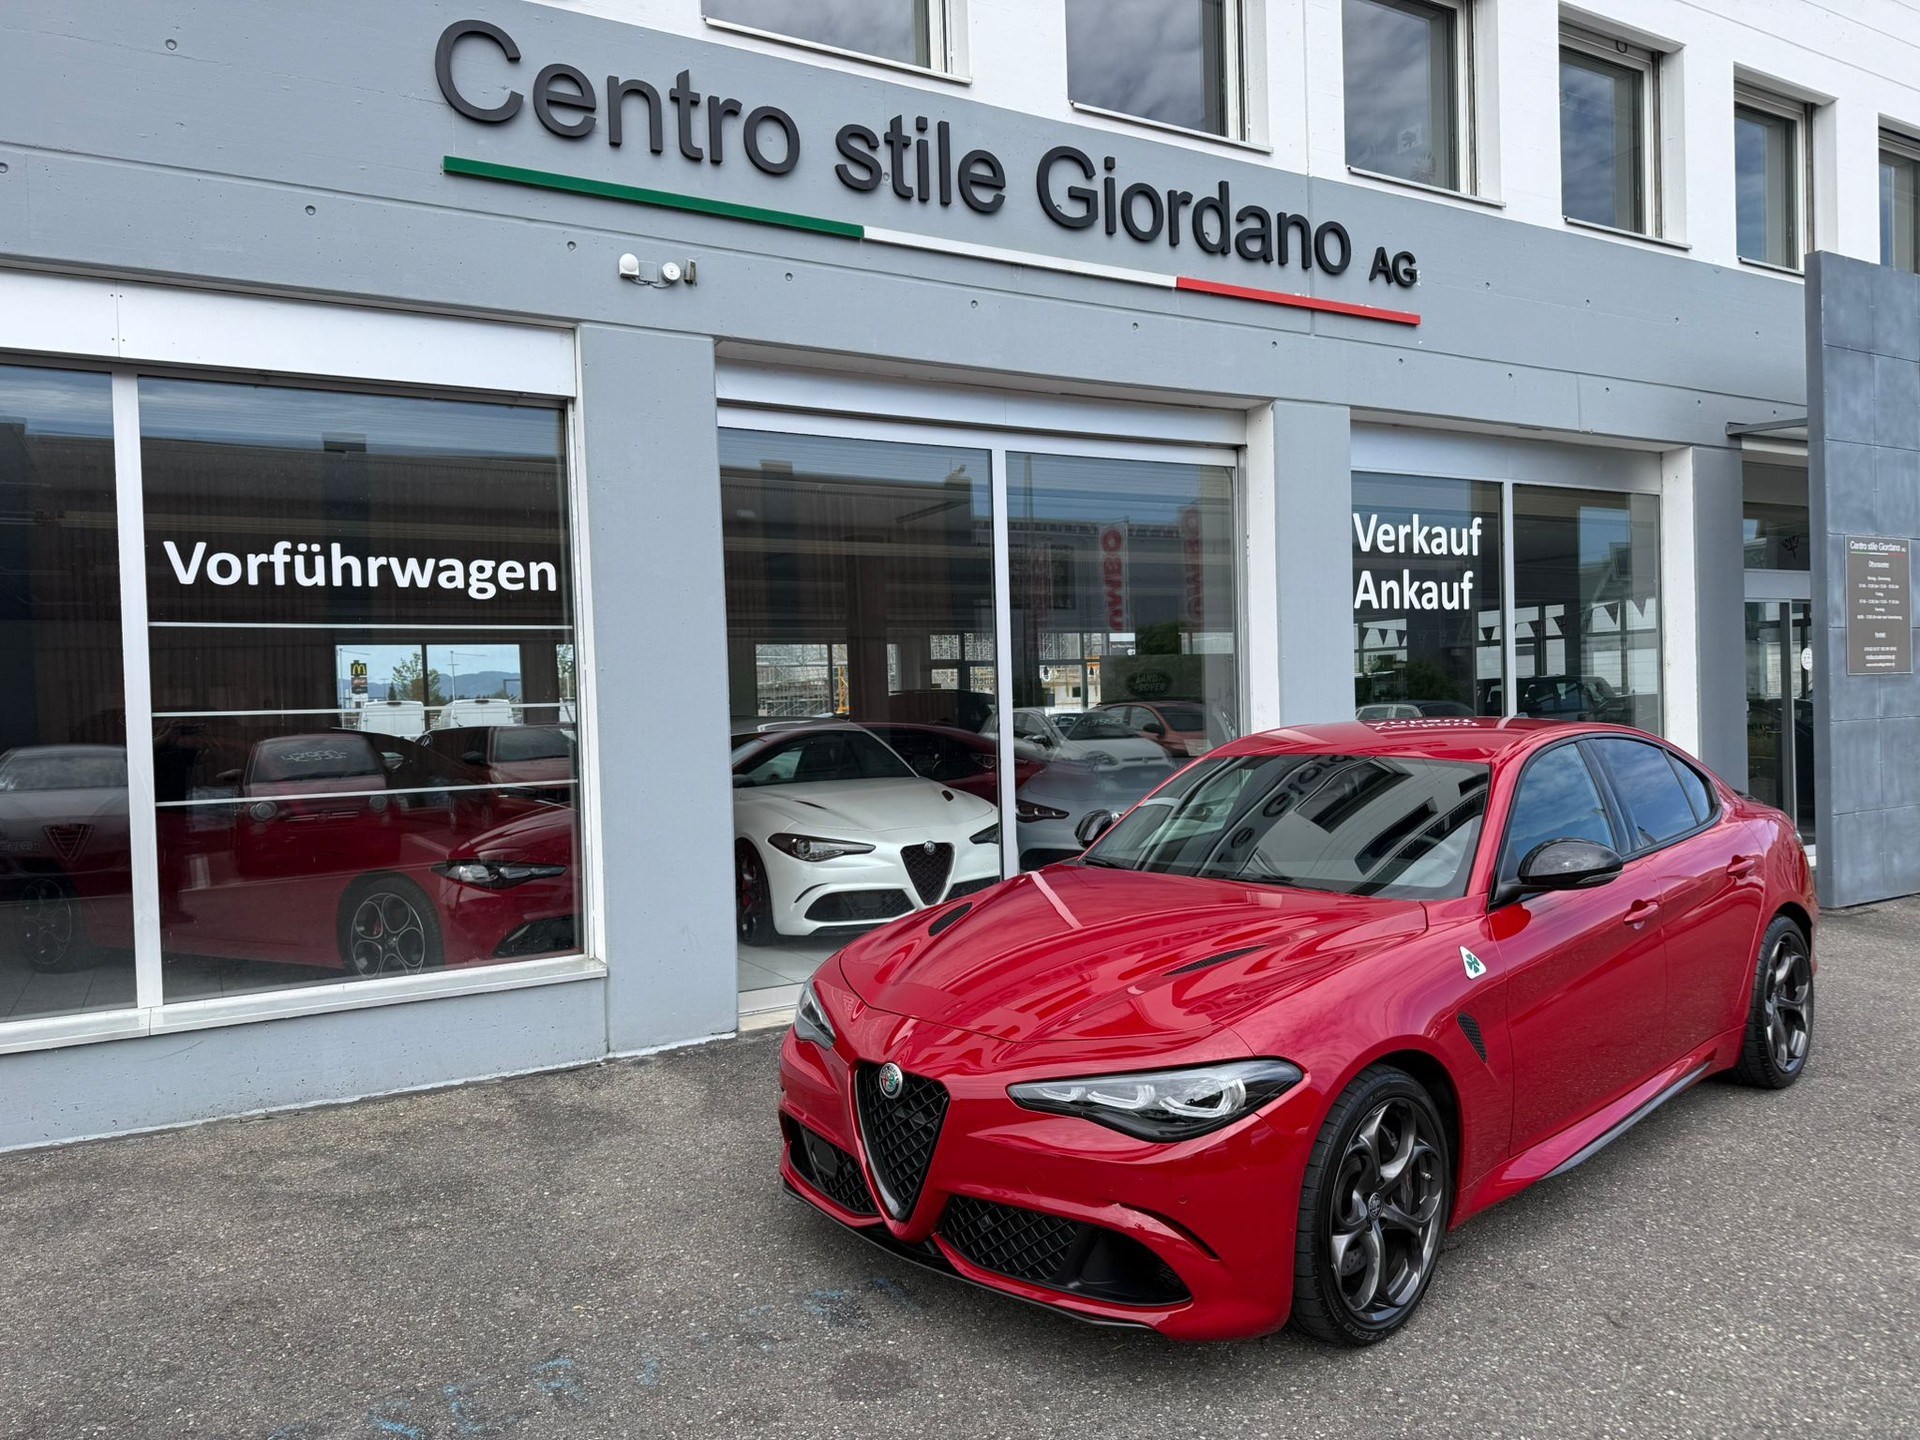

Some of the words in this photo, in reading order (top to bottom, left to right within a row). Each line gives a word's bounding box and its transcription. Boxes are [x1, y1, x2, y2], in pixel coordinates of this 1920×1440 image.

[434, 19, 800, 177] Centro
[834, 113, 1007, 214] stile
[1036, 145, 1352, 275] Giordano
[1368, 246, 1419, 288] AG
[1352, 513, 1483, 557] Verkauf
[1849, 540, 1868, 551] Centro
[163, 540, 558, 600] Vorführwagen
[1353, 569, 1474, 610] Ankauf
